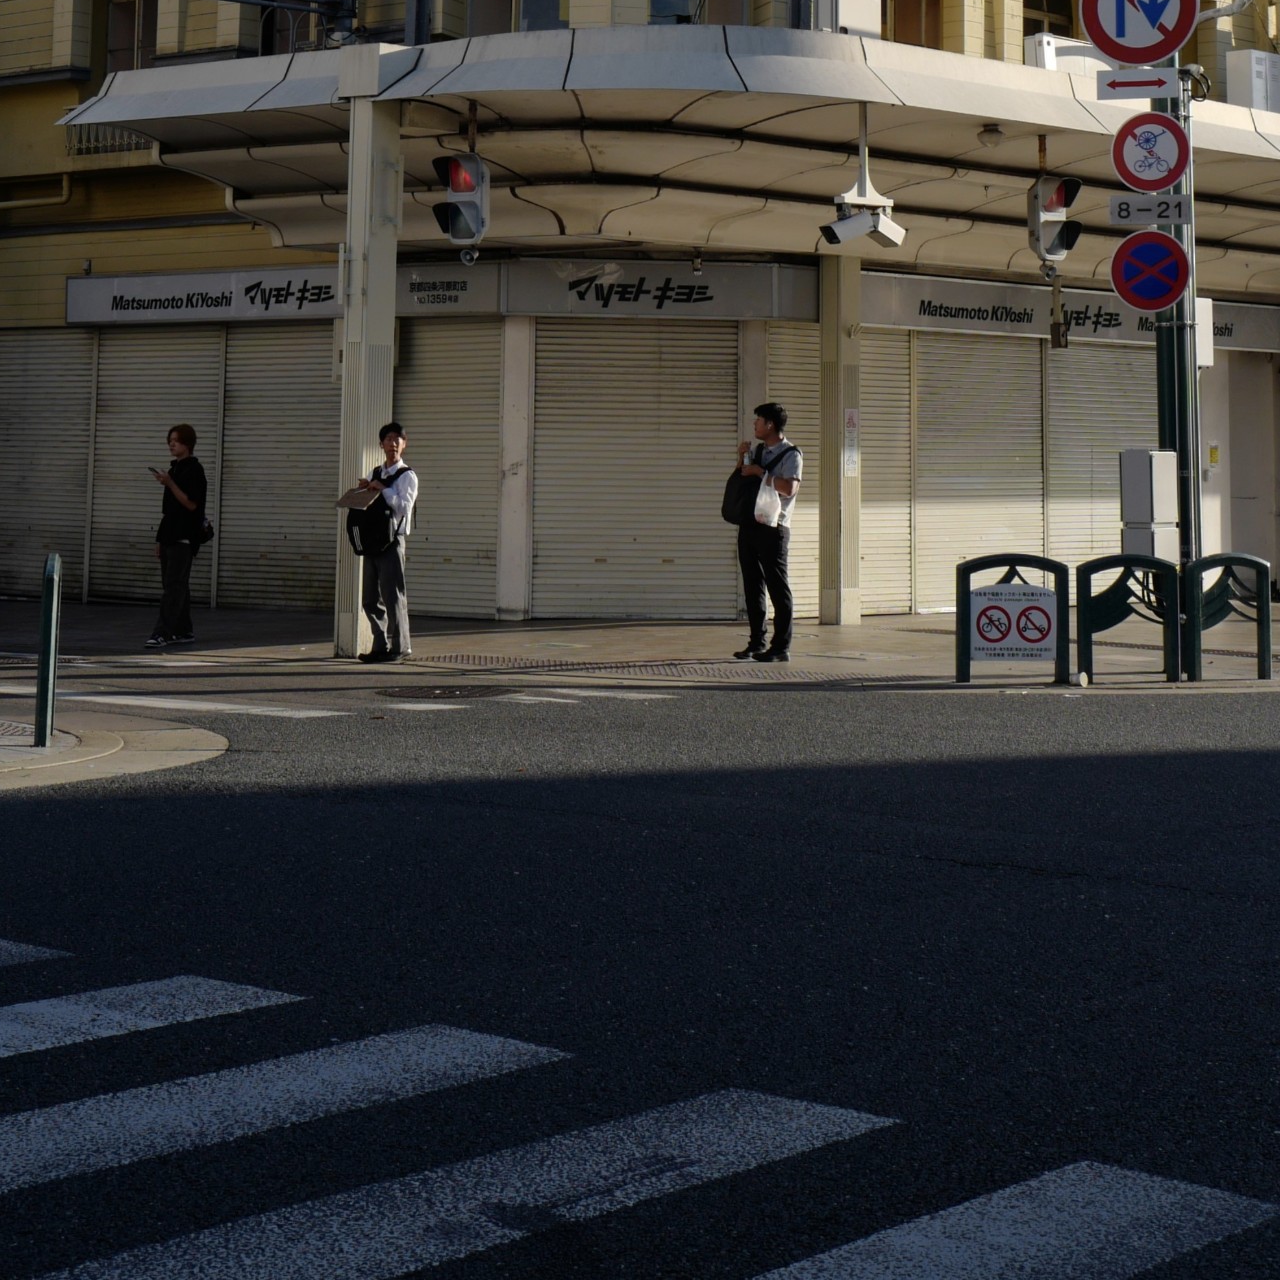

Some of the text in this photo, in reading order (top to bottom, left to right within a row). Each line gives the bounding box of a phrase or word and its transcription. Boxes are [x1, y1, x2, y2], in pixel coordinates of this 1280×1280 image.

[244, 280, 335, 310] マツモトキヨシ
[409, 280, 468, 293] 京都四条河原町店
[568, 275, 714, 309] マツモトキヨシ
[111, 291, 233, 311] Matsumoto KiYoshi
[918, 300, 1034, 324] Matsumoto KiYoshi
